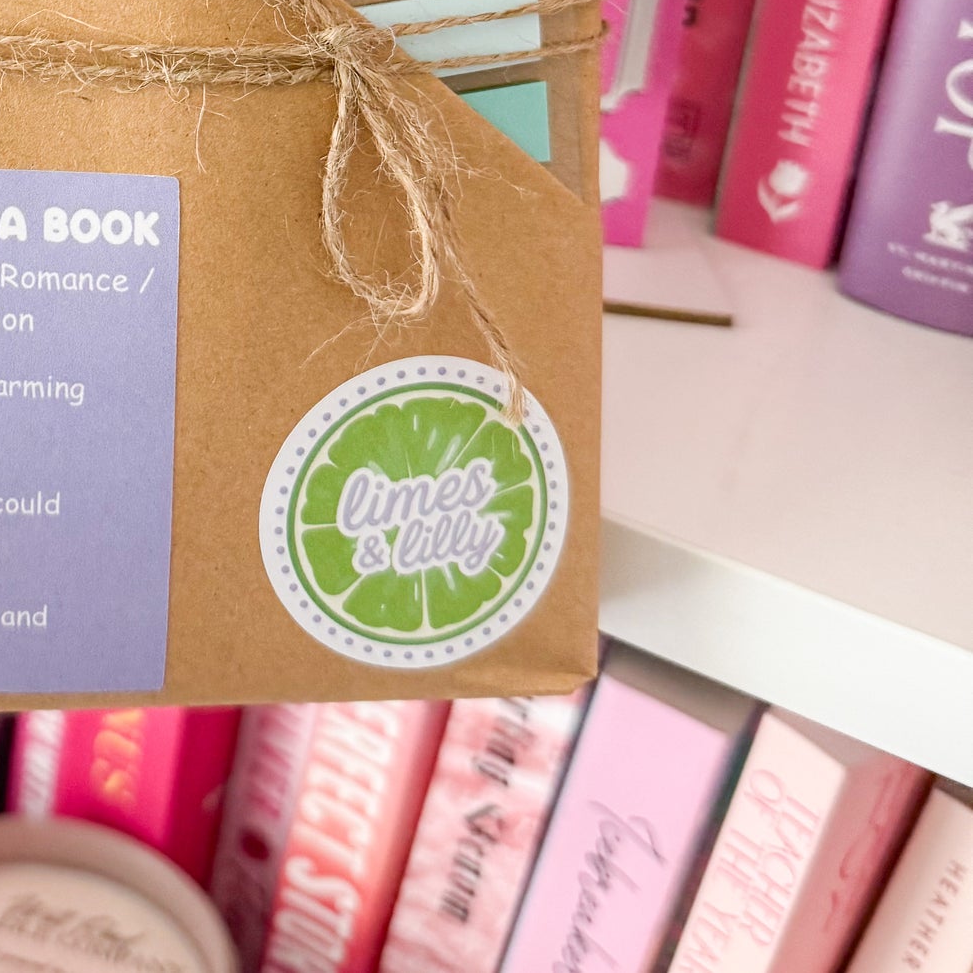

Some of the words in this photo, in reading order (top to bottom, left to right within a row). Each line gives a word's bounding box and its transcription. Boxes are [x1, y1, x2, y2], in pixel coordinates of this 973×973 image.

[0, 206, 27, 242] A
[44, 208, 160, 247] BOOK
[0, 263, 129, 293] Romance
[140, 267, 155, 295] /
[342, 463, 491, 531] limes
[358, 535, 386, 569] &
[399, 510, 499, 570] lilly
[1, 605, 48, 628] and
[741, 768, 785, 817] OF
[717, 829, 765, 890] THE
[740, 794, 822, 947] TEACHER
[902, 859, 969, 971] HEATHER
